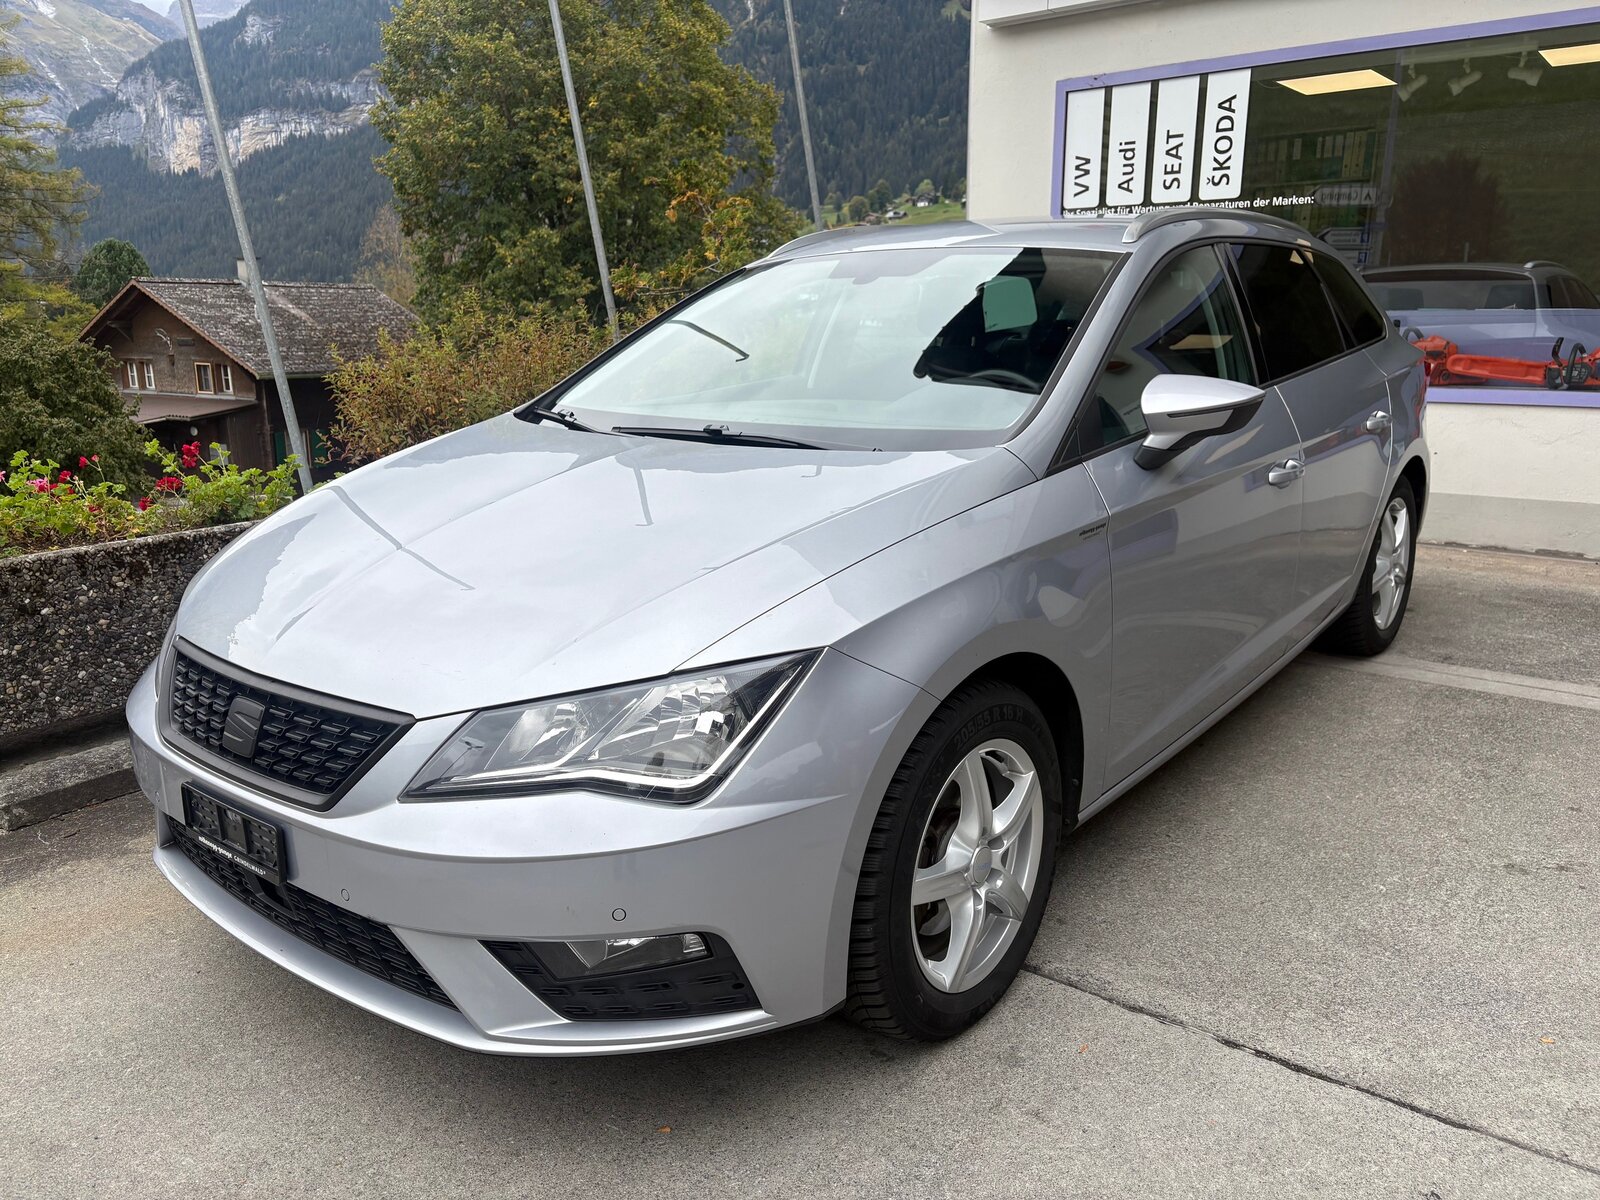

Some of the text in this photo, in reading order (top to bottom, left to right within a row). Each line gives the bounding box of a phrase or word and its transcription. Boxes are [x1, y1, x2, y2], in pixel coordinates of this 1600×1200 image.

[1163, 130, 1184, 190] SEAT
[1206, 94, 1237, 187] ŠKODA
[1073, 155, 1091, 197] VW
[1117, 140, 1136, 194] Audi
[1117, 205, 1130, 215] für
[1252, 197, 1270, 207] der
[1272, 195, 1315, 206] Marken:
[954, 710, 991, 751] 205/55
[993, 707, 1000, 722] R
[1004, 705, 1013, 720] 16
